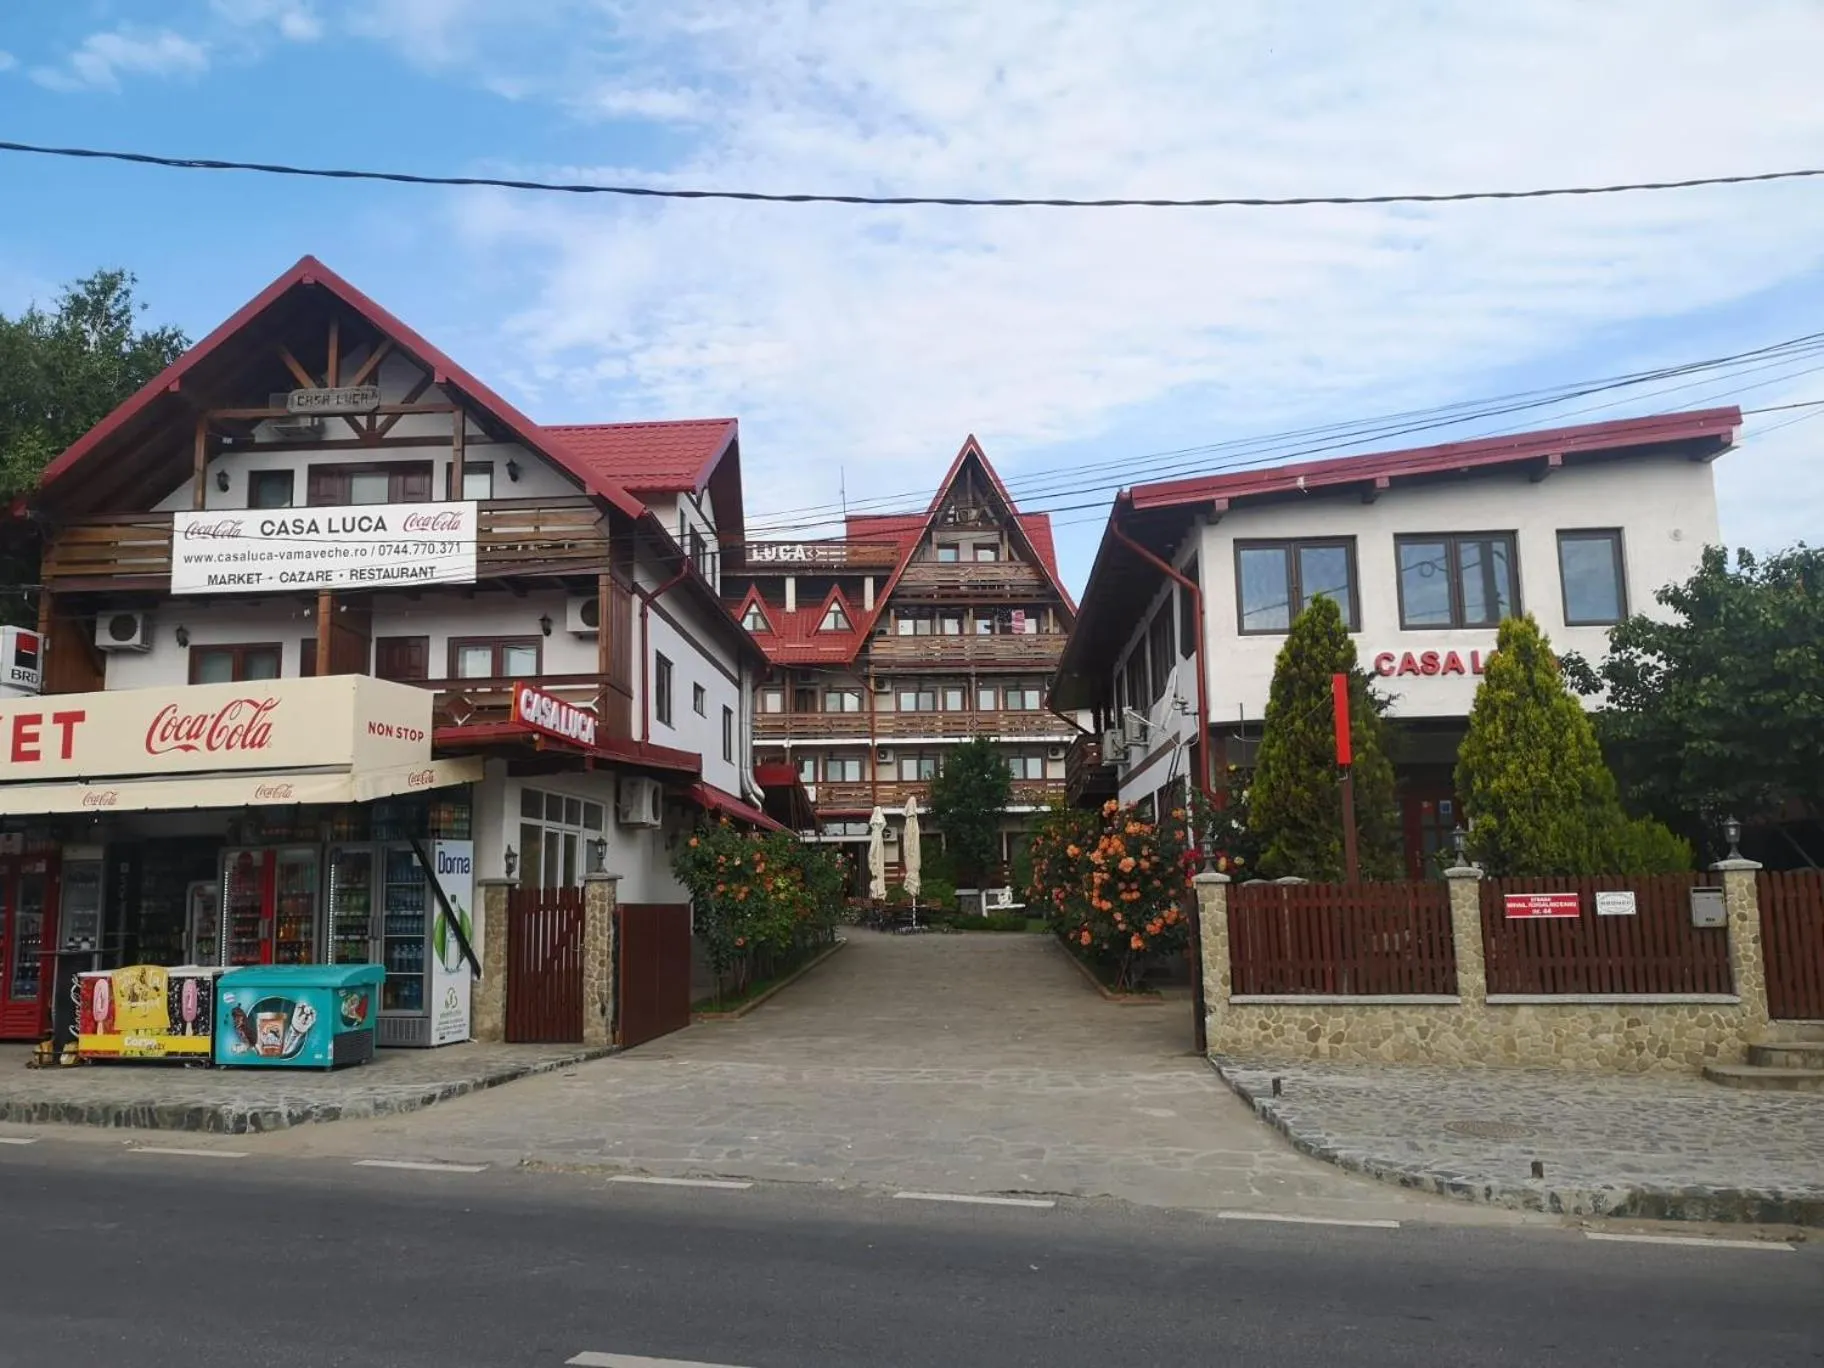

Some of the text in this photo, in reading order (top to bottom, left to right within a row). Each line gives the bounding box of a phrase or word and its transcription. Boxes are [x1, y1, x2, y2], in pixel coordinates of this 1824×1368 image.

[260, 515, 387, 536] CASA LUCA
[184, 546, 367, 564] www.casaluca-vamaveche.ro
[378, 542, 461, 556] 0744.770.371
[207, 566, 436, 586] MARKET CAZARE RESTAURANT
[1375, 651, 1465, 676] CASA
[11, 668, 39, 684] BRD
[0, 710, 86, 762] ET
[145, 697, 282, 754] Coca-Cola
[368, 721, 424, 742] NON STOP
[438, 851, 470, 874] Dorna
